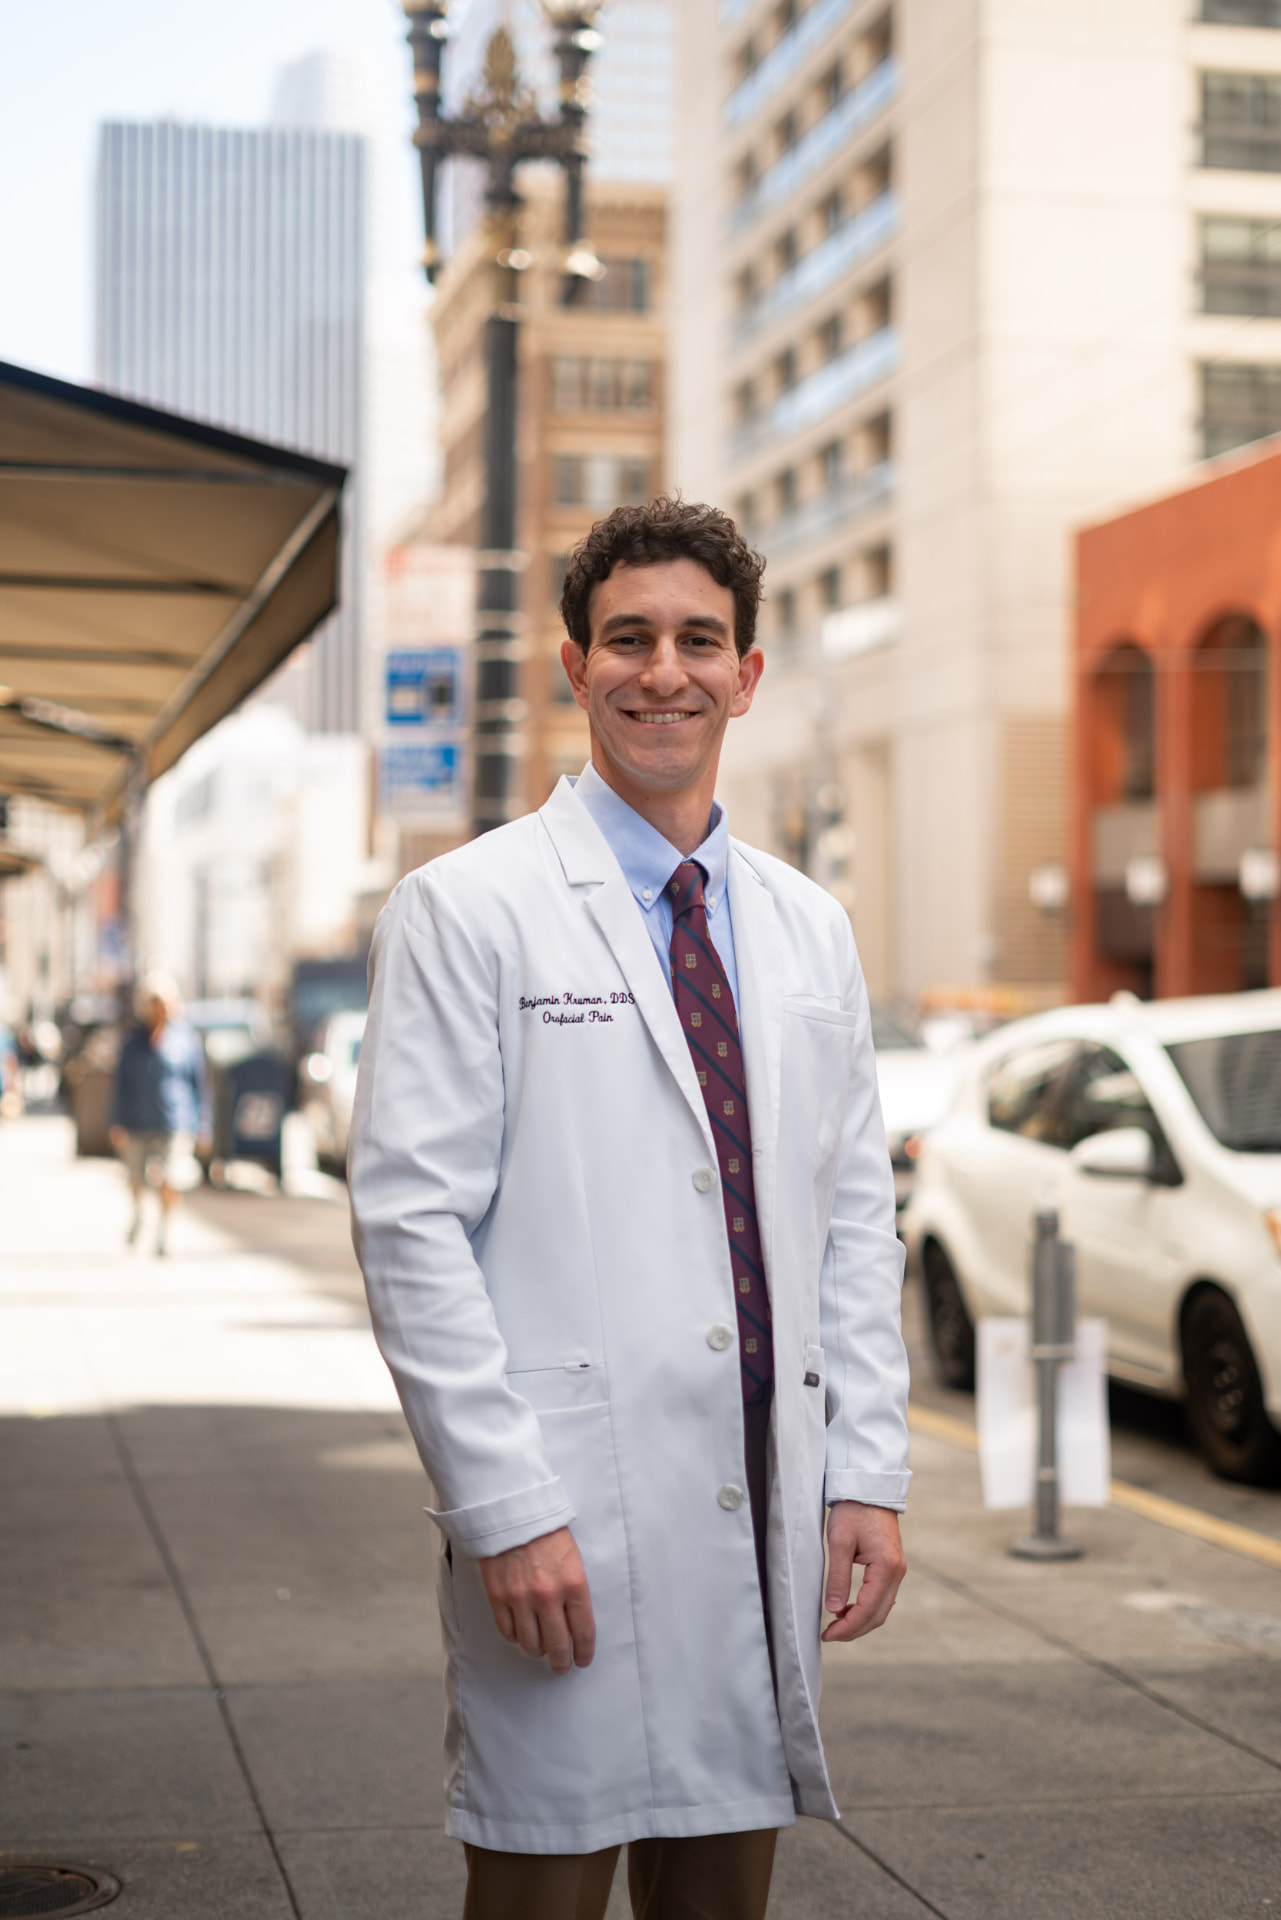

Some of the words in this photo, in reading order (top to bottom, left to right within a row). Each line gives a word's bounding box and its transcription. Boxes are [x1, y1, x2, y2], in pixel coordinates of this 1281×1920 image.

[519, 995, 560, 1011] Benjamin
[610, 992, 636, 1005] DDS
[542, 1011, 585, 1026] Orofacial
[588, 1010, 614, 1023] Pain
